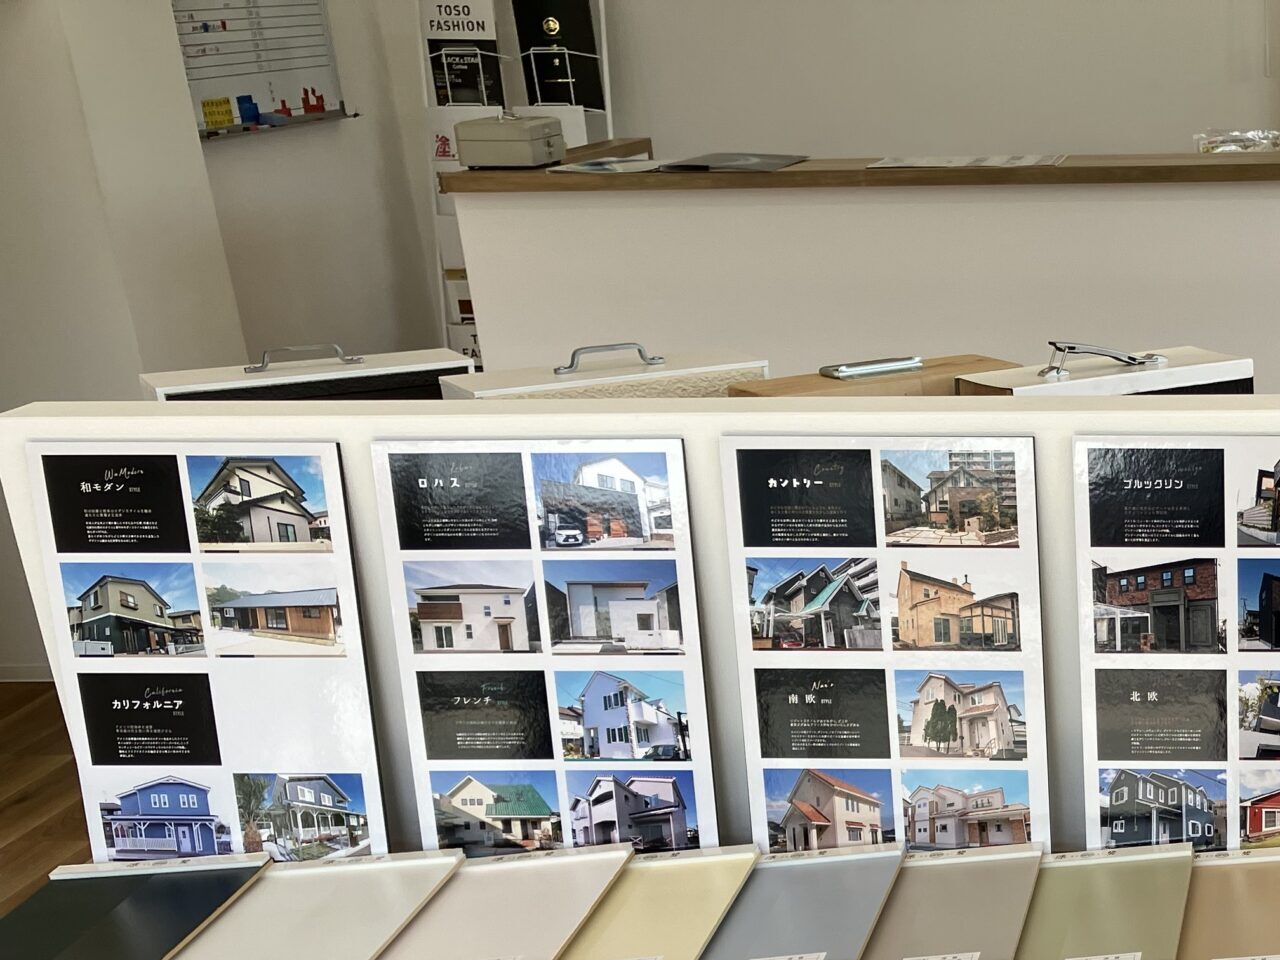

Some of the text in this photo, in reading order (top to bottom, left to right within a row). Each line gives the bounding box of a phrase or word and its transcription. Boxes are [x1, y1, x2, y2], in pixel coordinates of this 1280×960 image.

[436, 4, 471, 16] TOSO
[429, 20, 486, 32] FASHION
[80, 481, 125, 493] 和モダン
[418, 478, 460, 488] ロハス
[768, 478, 823, 488] カントリー
[1123, 479, 1183, 489] ブルックリン
[453, 696, 491, 705] フレンチ
[788, 694, 816, 704] 南欧
[1130, 691, 1158, 702] 北欧
[112, 699, 183, 710] カリフォルニア
